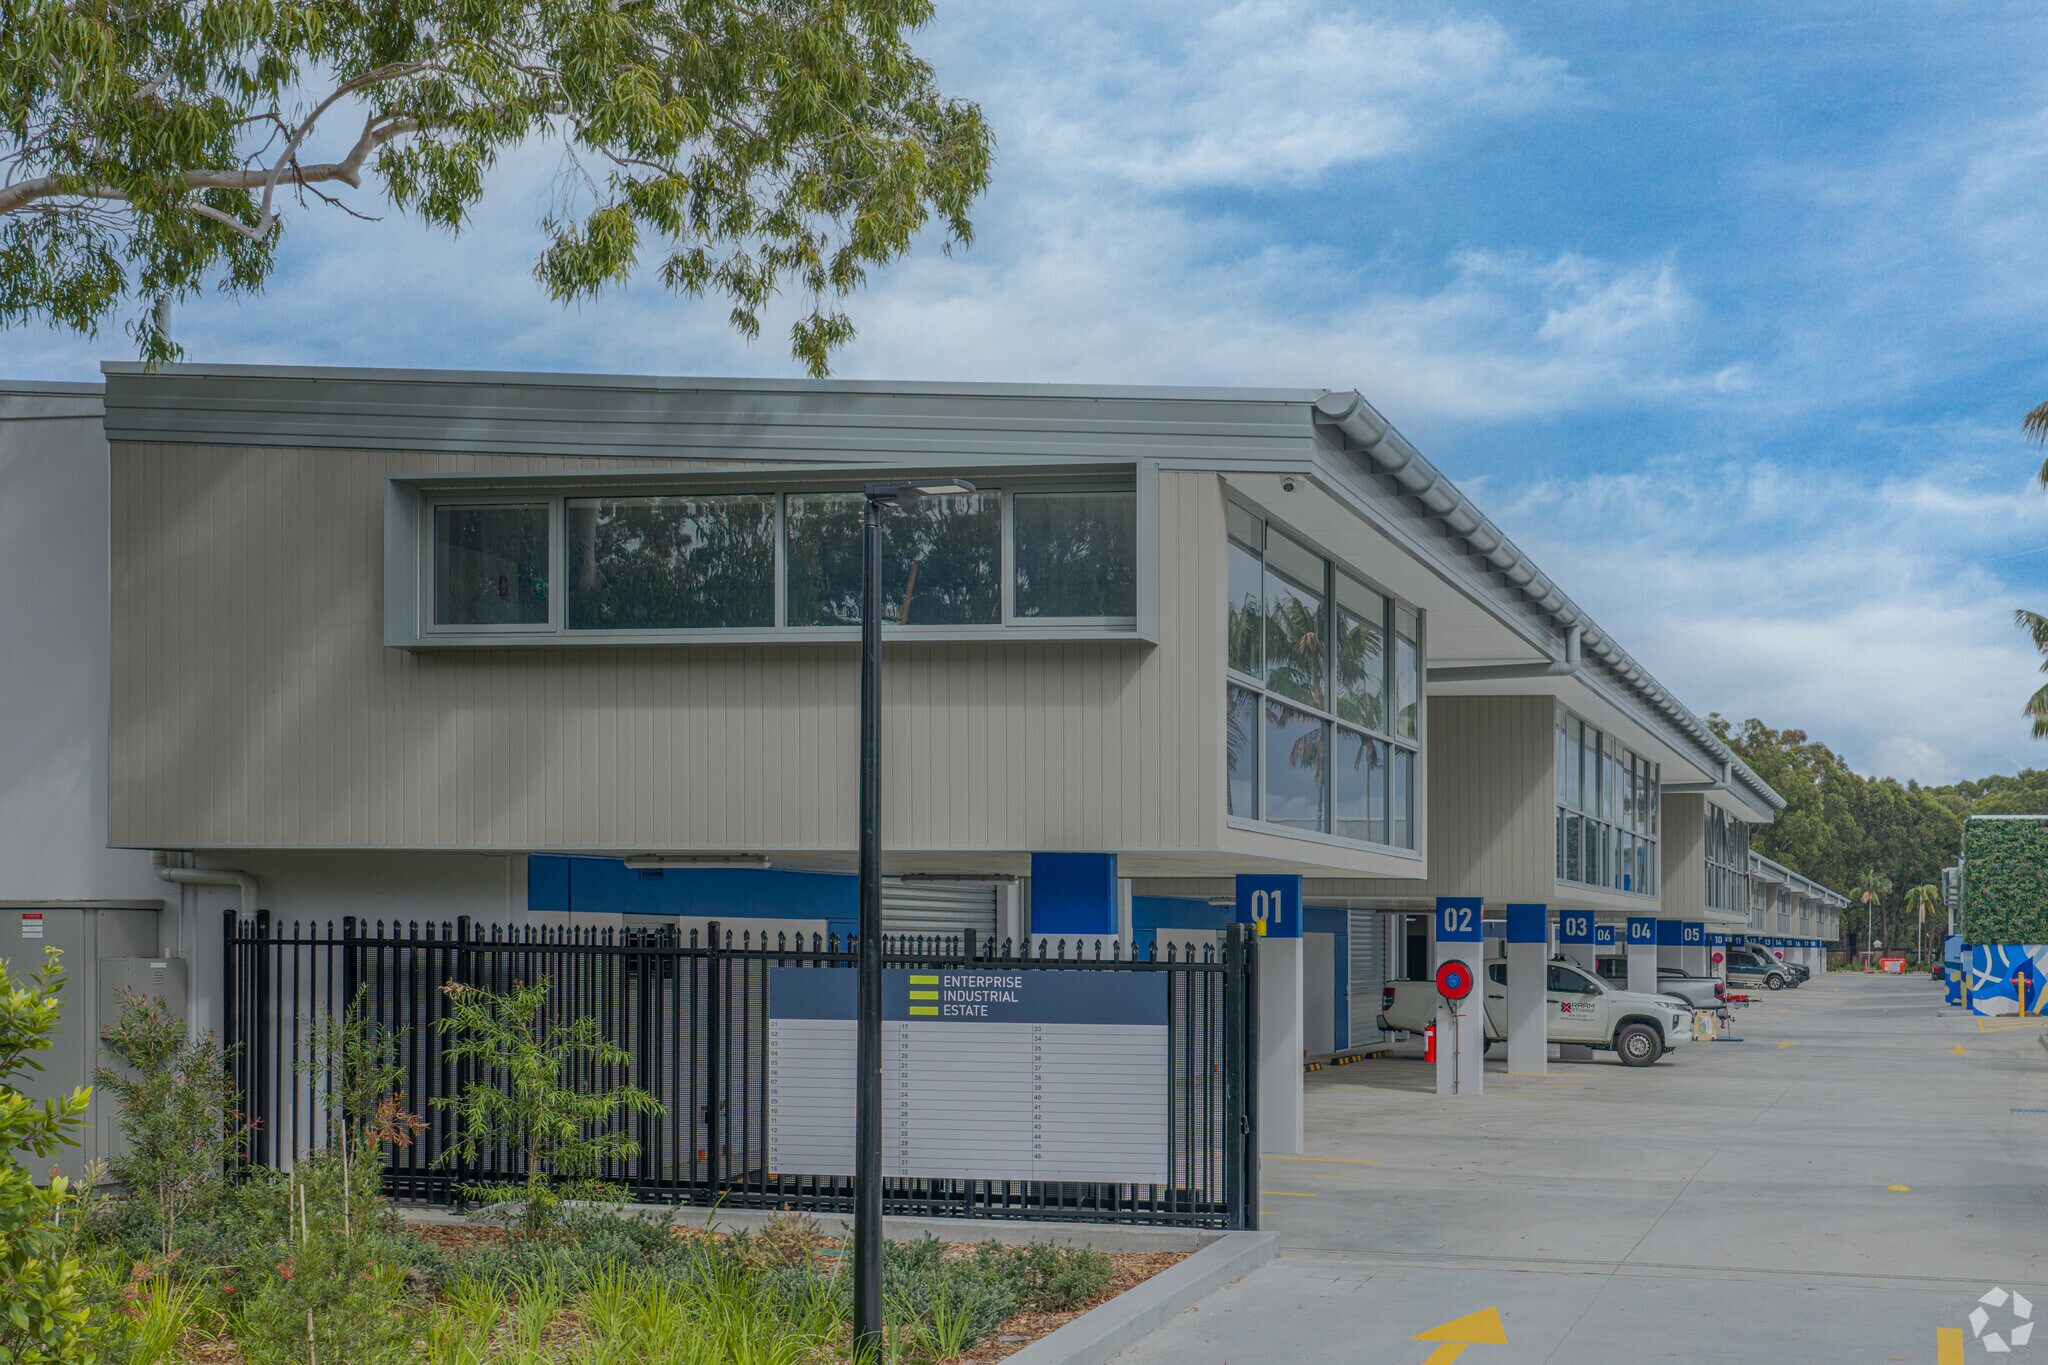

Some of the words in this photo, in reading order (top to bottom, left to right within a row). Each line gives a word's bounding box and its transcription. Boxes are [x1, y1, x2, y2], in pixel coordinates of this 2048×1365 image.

[1251, 890, 1282, 923] 01
[1444, 907, 1472, 932] 02
[1565, 917, 1588, 936] 03
[1631, 922, 1651, 939] 04
[1597, 929, 1611, 941] 06
[1684, 928, 1700, 942] 05
[1714, 936, 1722, 944] 10
[944, 976, 1022, 988] ENTERPRISE
[944, 990, 1018, 1002] INDUSTRIAL
[944, 1004, 988, 1016] ESTATE
